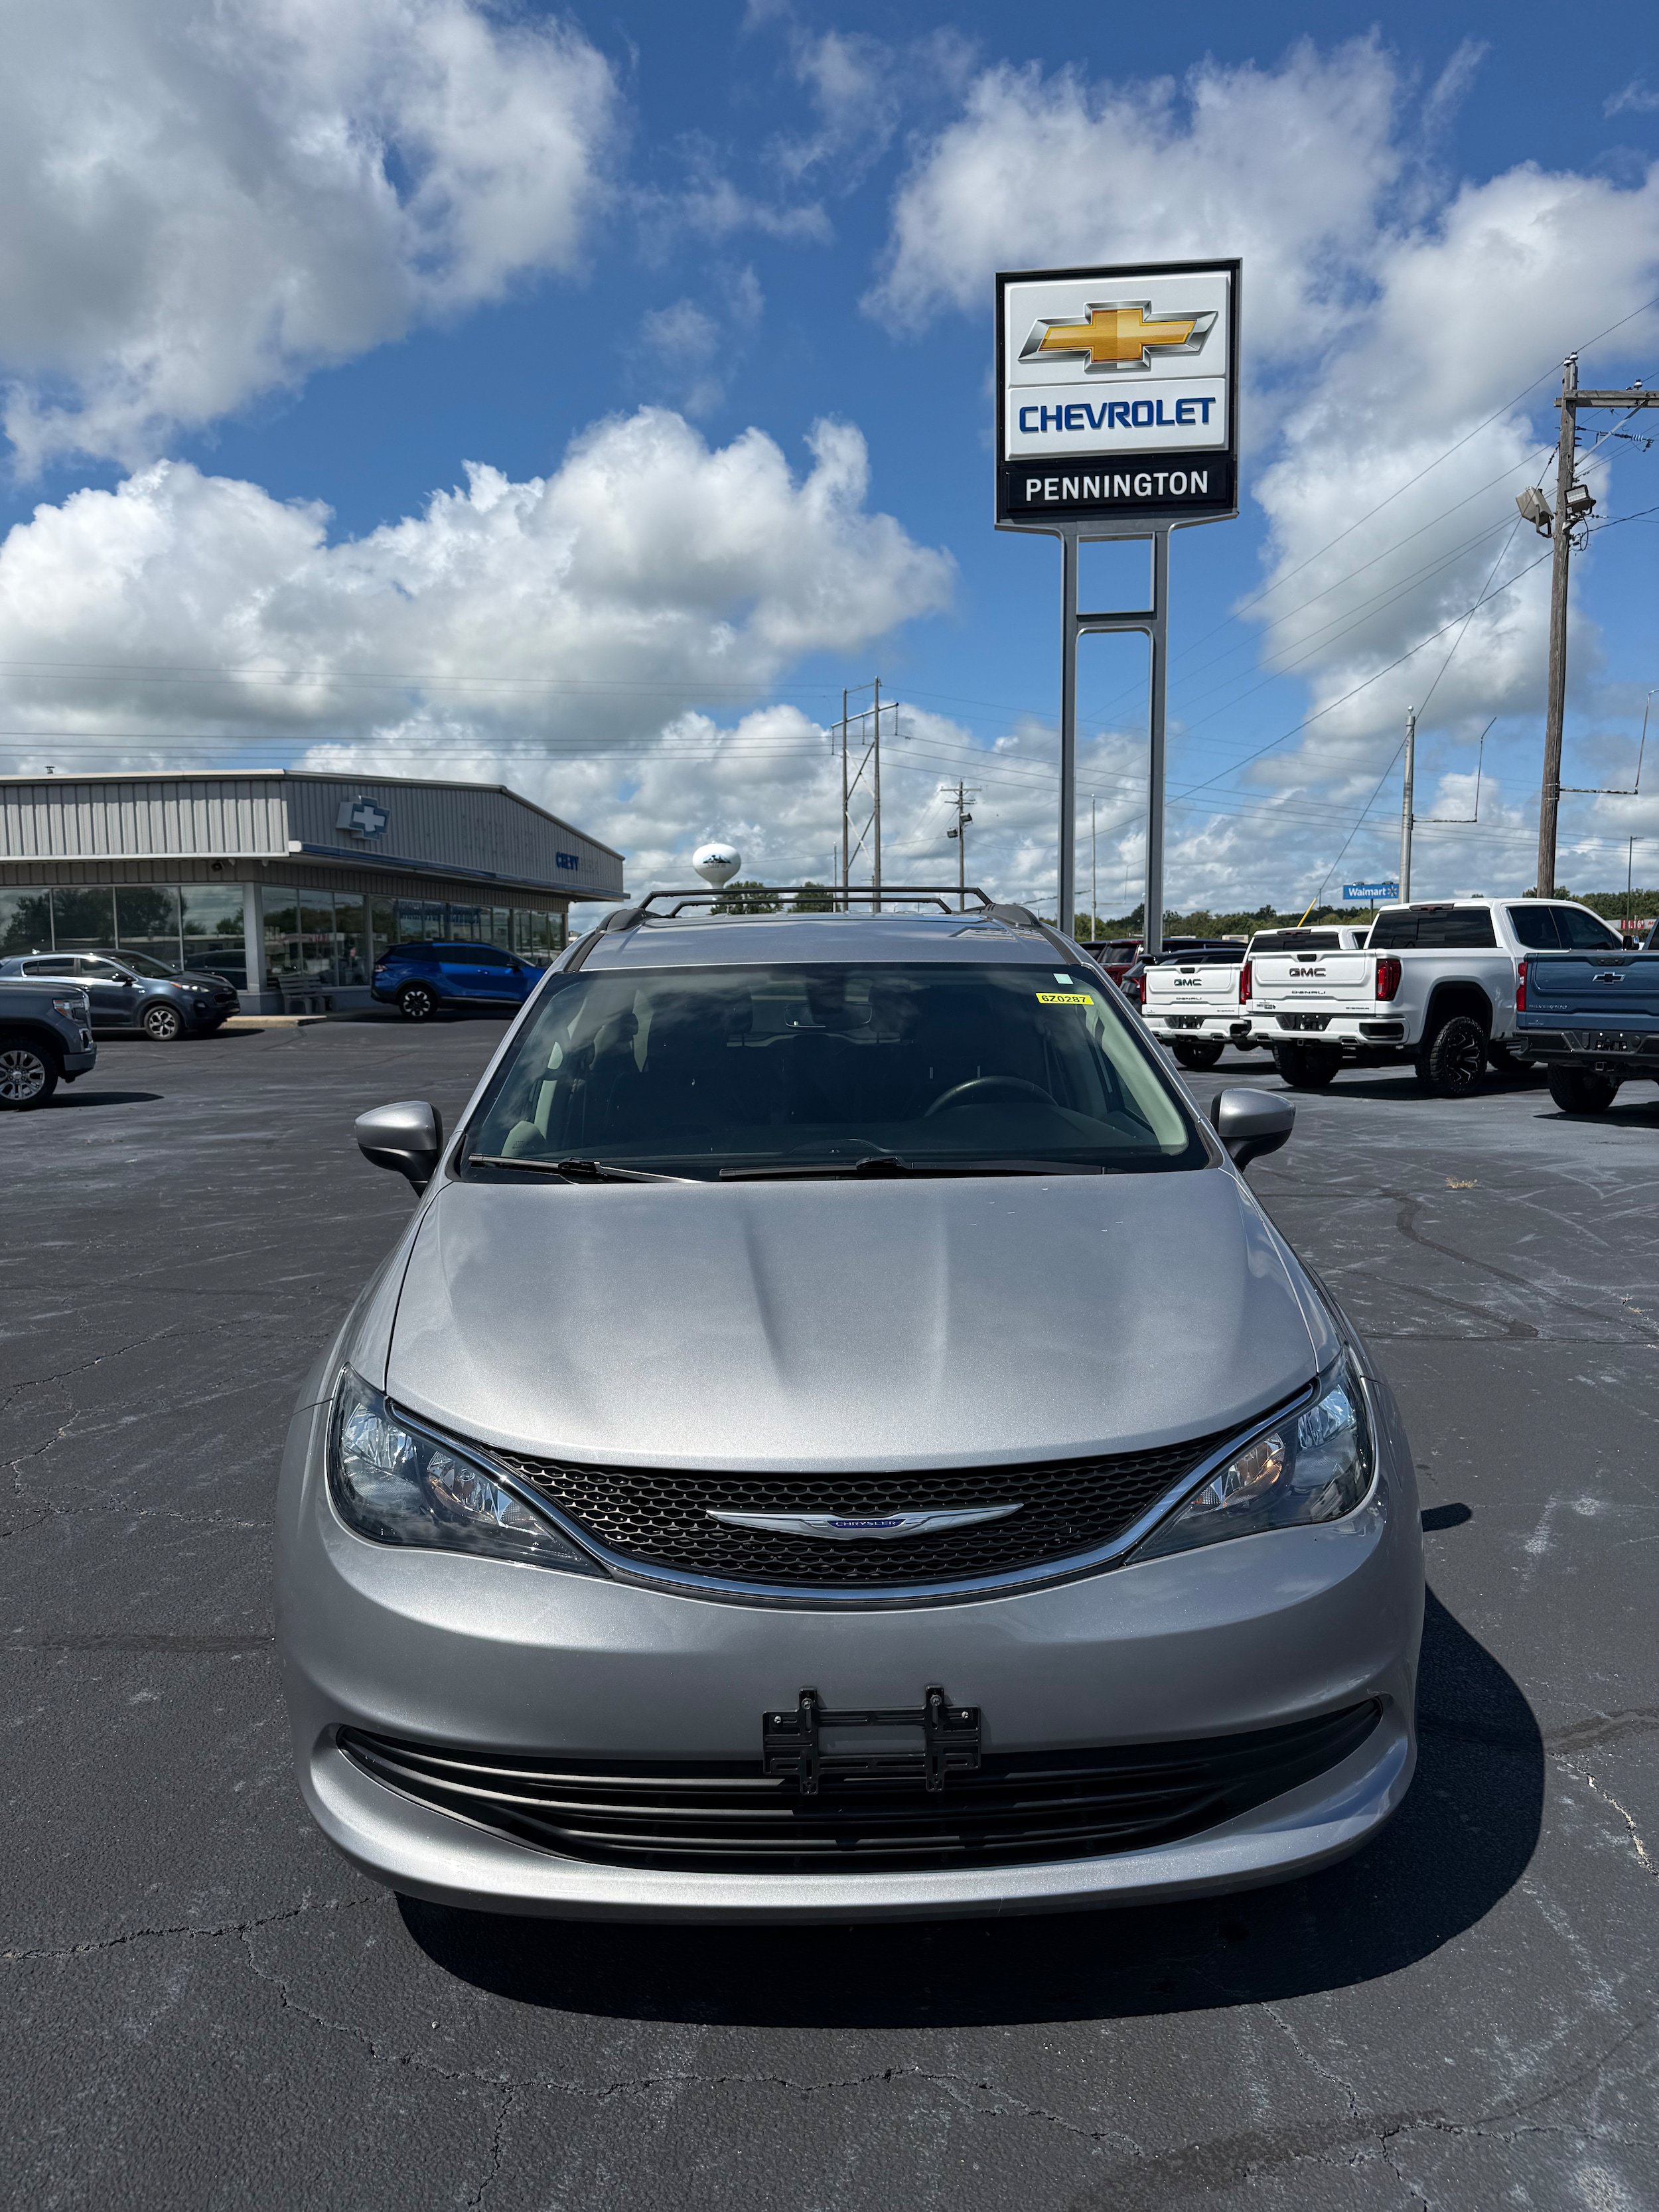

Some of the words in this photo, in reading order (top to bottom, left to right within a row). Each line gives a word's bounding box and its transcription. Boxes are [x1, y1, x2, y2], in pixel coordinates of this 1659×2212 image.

[1019, 397, 1216, 433] CHEVROLET
[1026, 471, 1208, 502] PENNINGTON
[556, 851, 579, 871] CHEVY
[1348, 887, 1386, 897] Walmart
[1289, 968, 1327, 977] GMC
